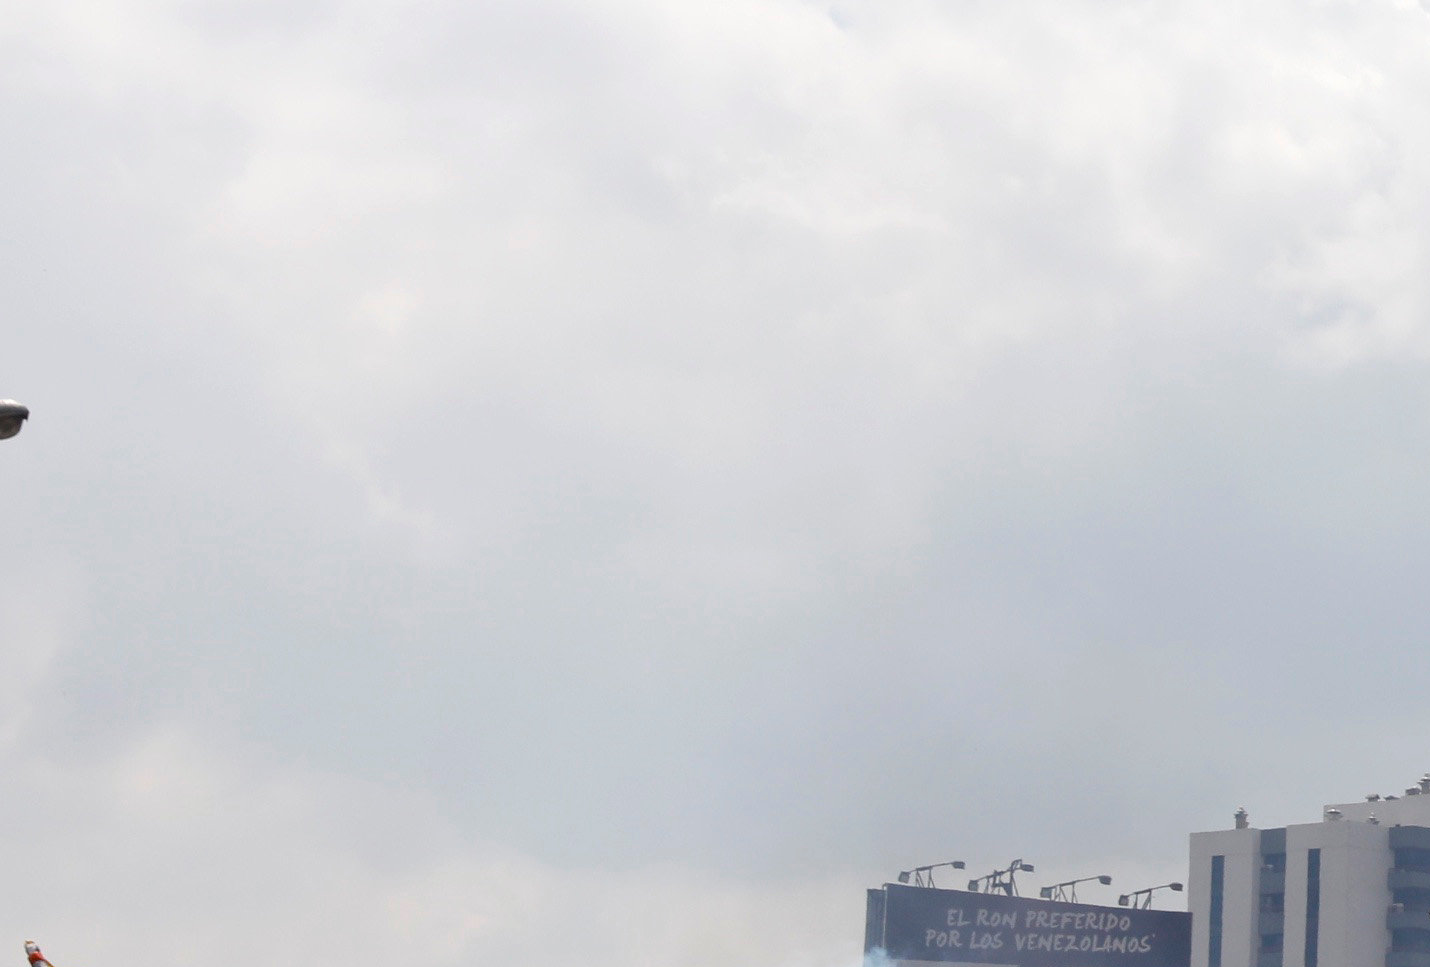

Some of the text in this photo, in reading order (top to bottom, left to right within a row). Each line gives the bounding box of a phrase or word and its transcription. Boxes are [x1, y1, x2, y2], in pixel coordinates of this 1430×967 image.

[946, 908, 1132, 931] EL RON PREFERIDO
[925, 928, 963, 948] POR
[969, 930, 1004, 951] LOS
